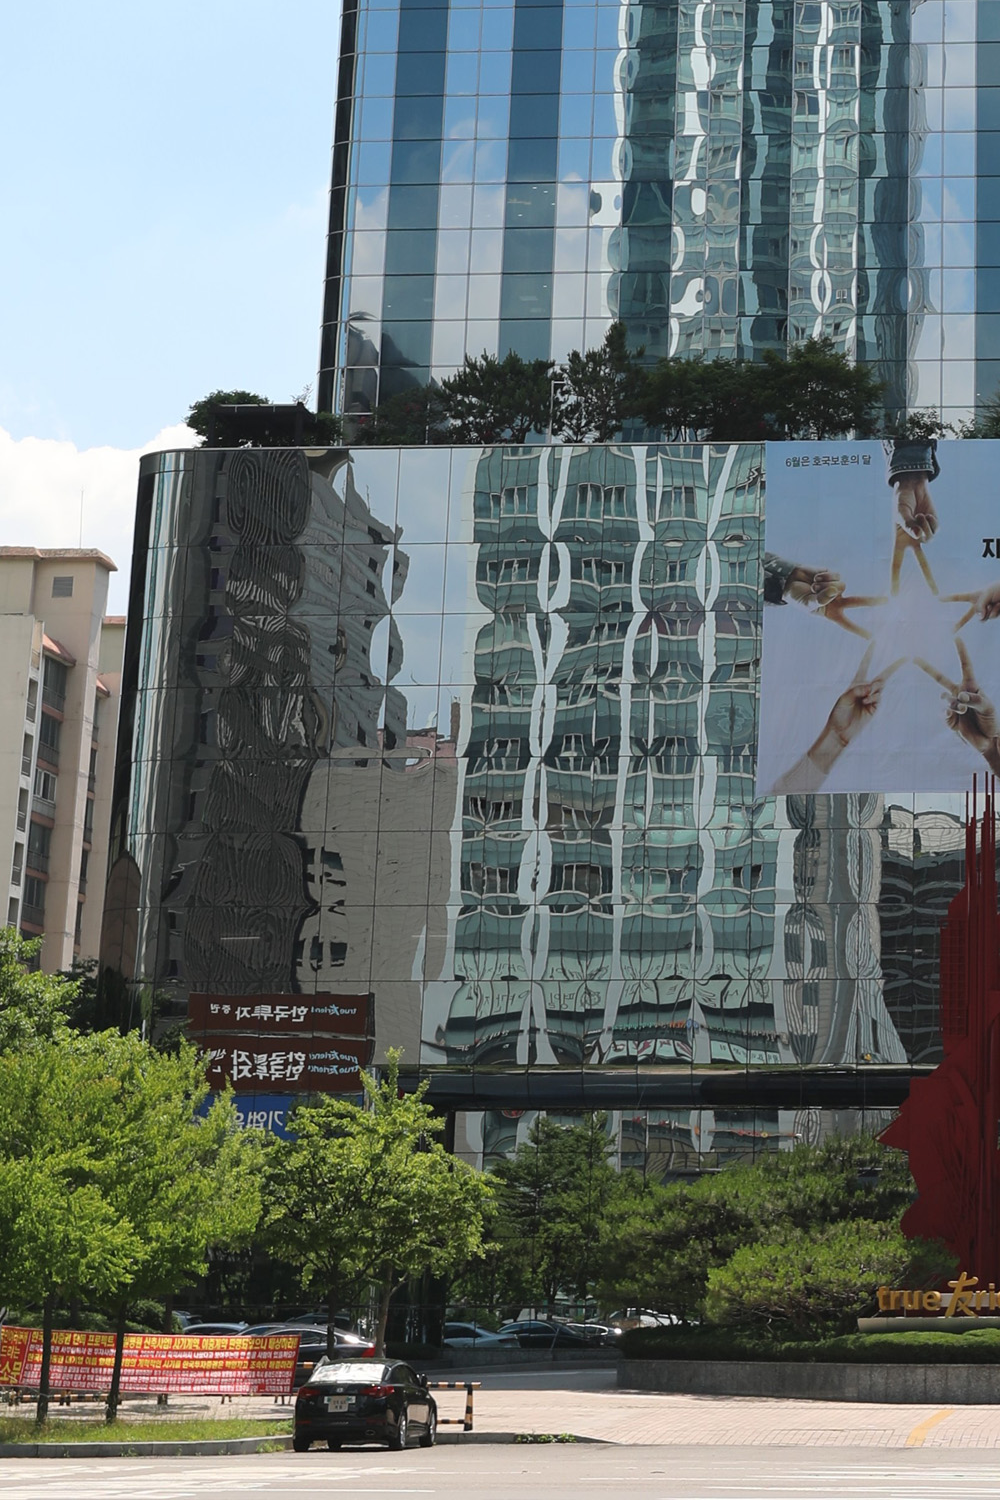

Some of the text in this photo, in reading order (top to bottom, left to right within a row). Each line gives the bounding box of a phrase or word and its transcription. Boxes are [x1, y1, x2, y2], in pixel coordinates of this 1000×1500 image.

[785, 455, 871, 468] 6월은 호국보훈의 달
